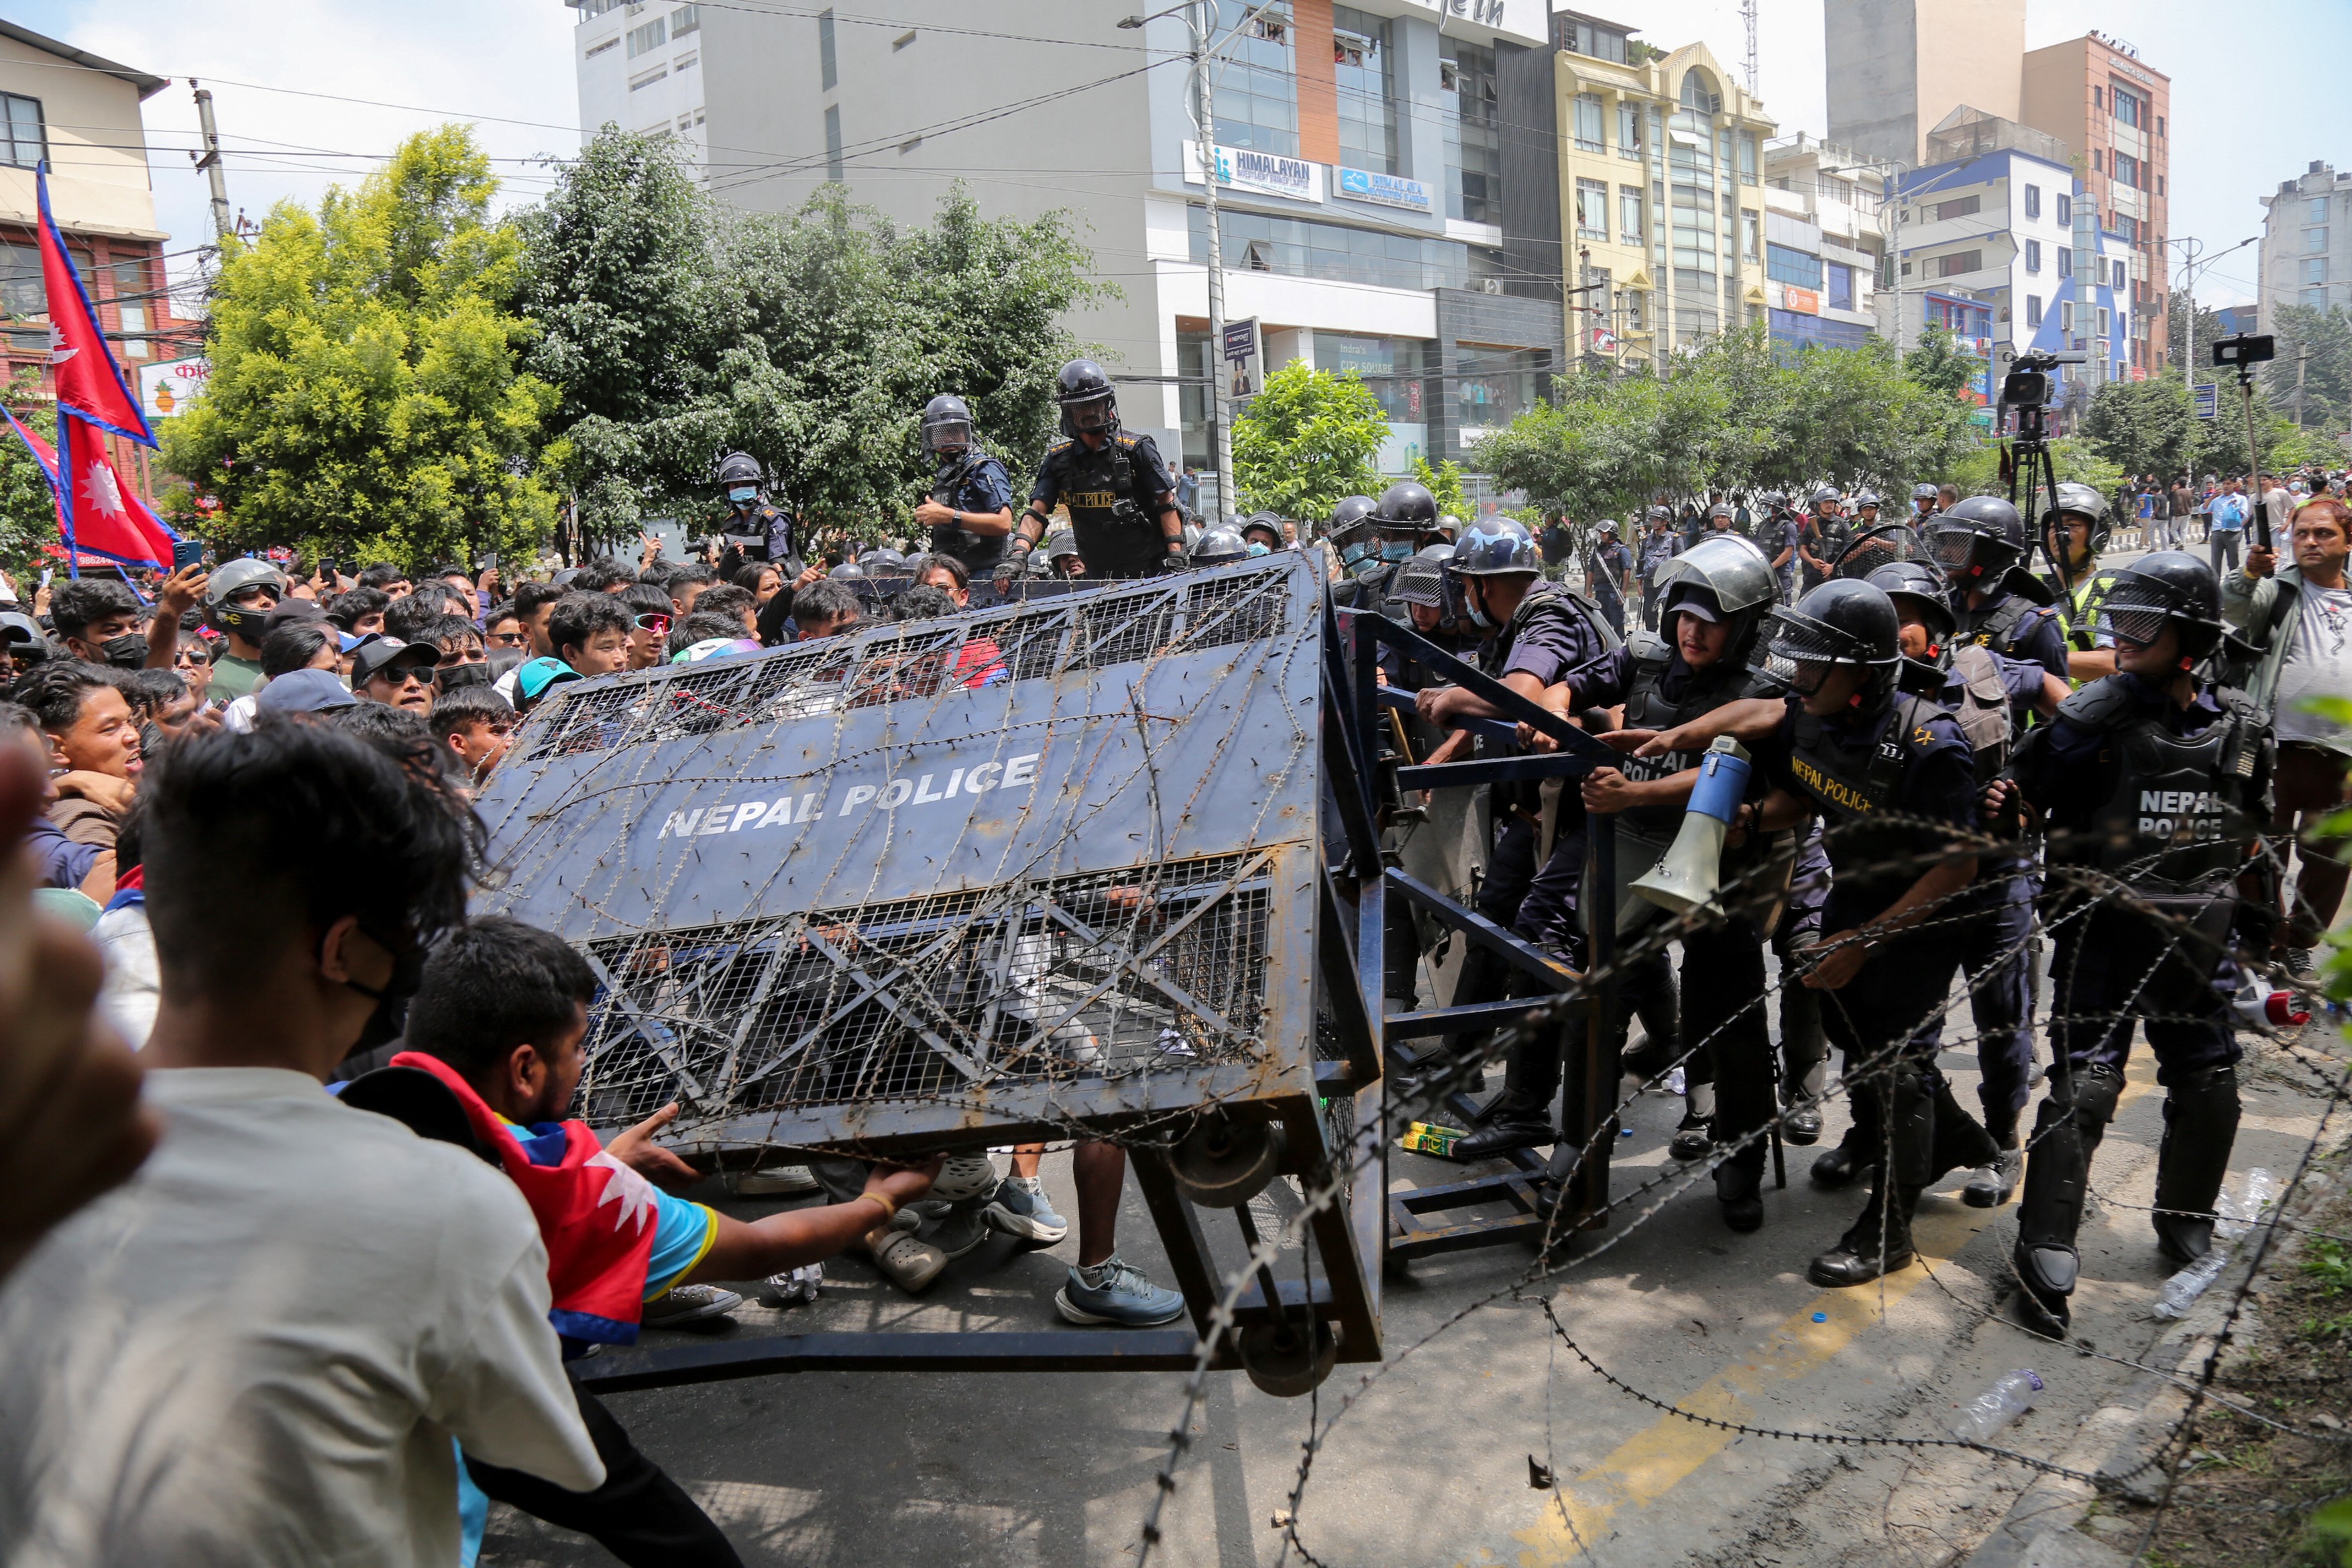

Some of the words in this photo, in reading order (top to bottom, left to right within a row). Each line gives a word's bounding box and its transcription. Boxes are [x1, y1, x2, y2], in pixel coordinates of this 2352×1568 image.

[1237, 151, 1310, 180] HIMALAYAN
[1340, 343, 1367, 355] Indra's
[1341, 359, 1359, 370] CITY
[1361, 361, 1394, 374] SQUARE
[1085, 493, 1114, 506] POLICE
[656, 792, 824, 840] NEPAL
[838, 752, 1041, 818] POLICE
[1792, 756, 1823, 791] NEPAL
[1824, 778, 1873, 816] POLICE
[2140, 790, 2223, 814] NEPAL
